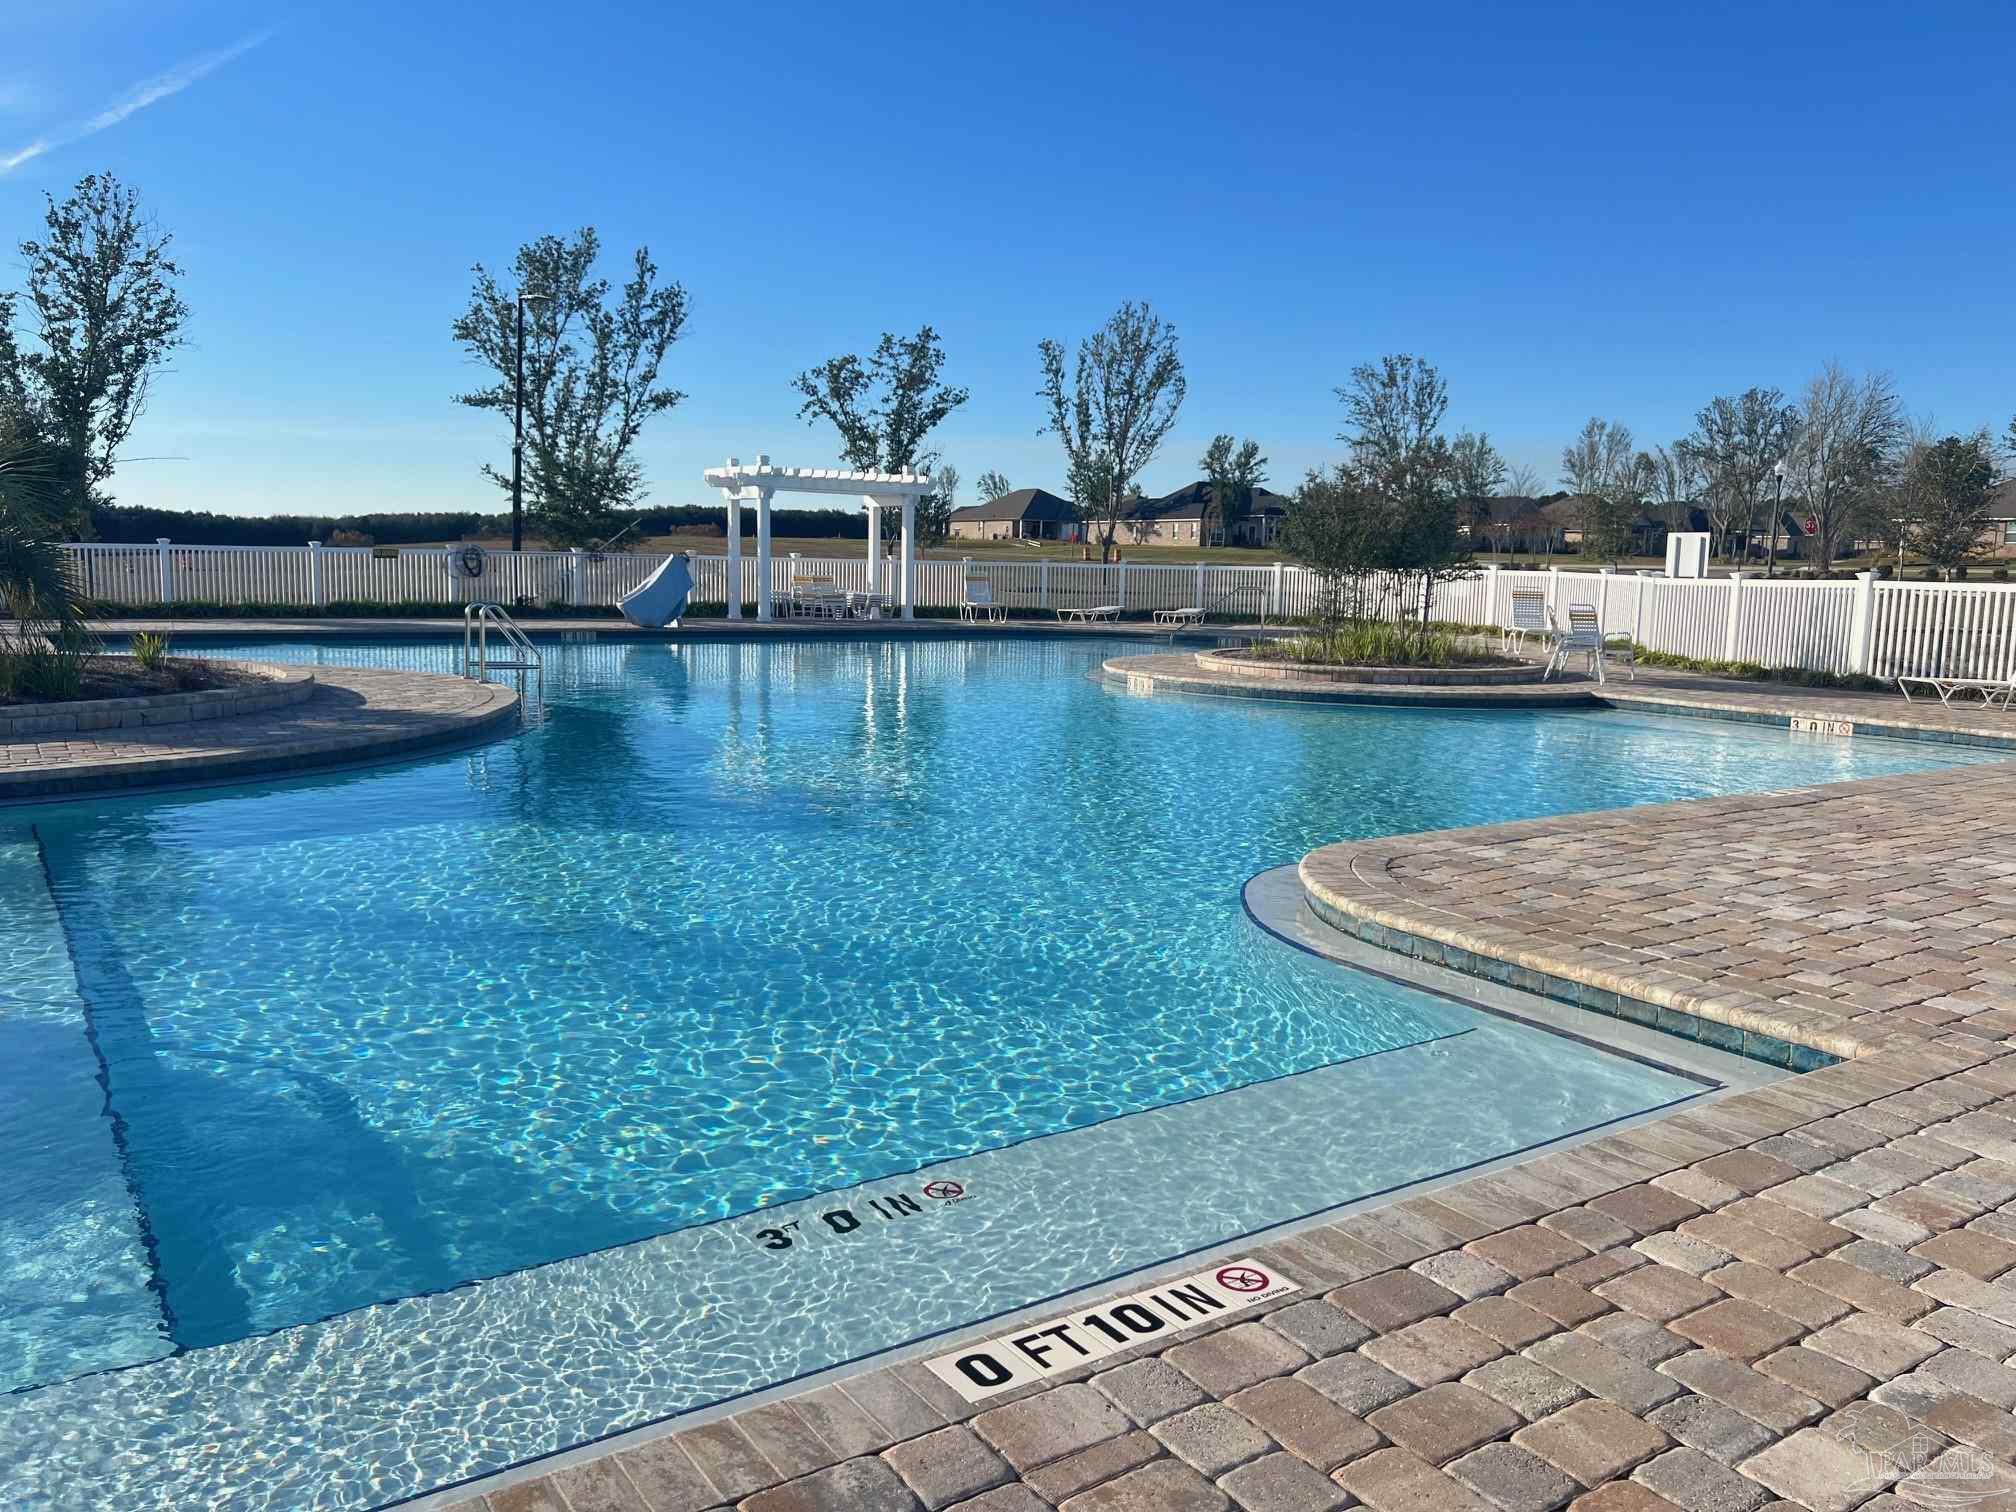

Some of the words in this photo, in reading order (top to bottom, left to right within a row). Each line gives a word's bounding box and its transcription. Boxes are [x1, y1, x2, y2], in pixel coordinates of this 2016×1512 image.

[822, 1209, 861, 1234] 0
[868, 1193, 923, 1219] IN
[1246, 1295, 1261, 1303] NO
[955, 1353, 1013, 1388] 0
[1011, 1324, 1090, 1369] FT
[1150, 1283, 1227, 1322] IN
